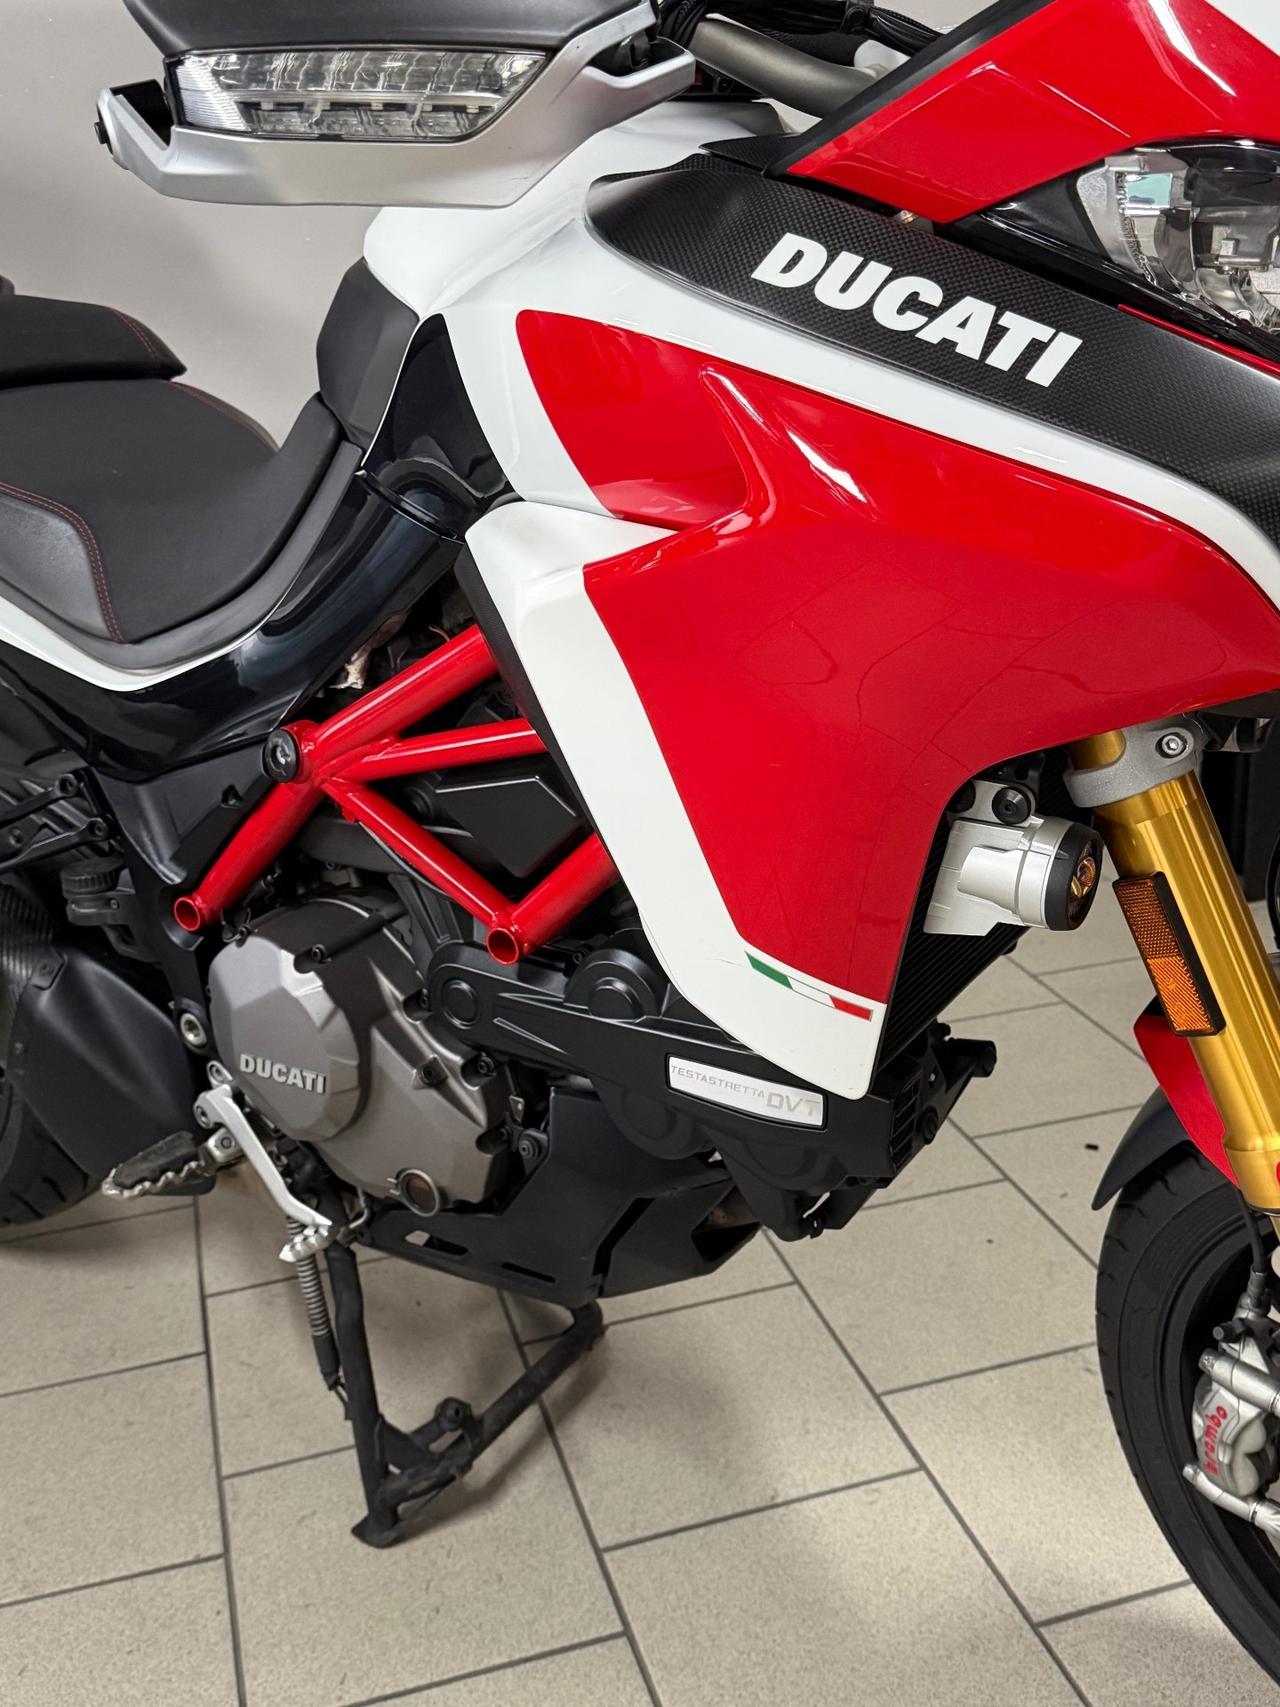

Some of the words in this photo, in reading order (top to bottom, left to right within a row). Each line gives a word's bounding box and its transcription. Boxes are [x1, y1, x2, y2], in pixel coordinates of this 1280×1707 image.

[751, 232, 1083, 387] DUCATI
[239, 1053, 327, 1094] DUCATI
[670, 1065, 766, 1099] TESTASTRETTA
[766, 1091, 821, 1117] DVT
[1204, 1405, 1228, 1474] brembo
